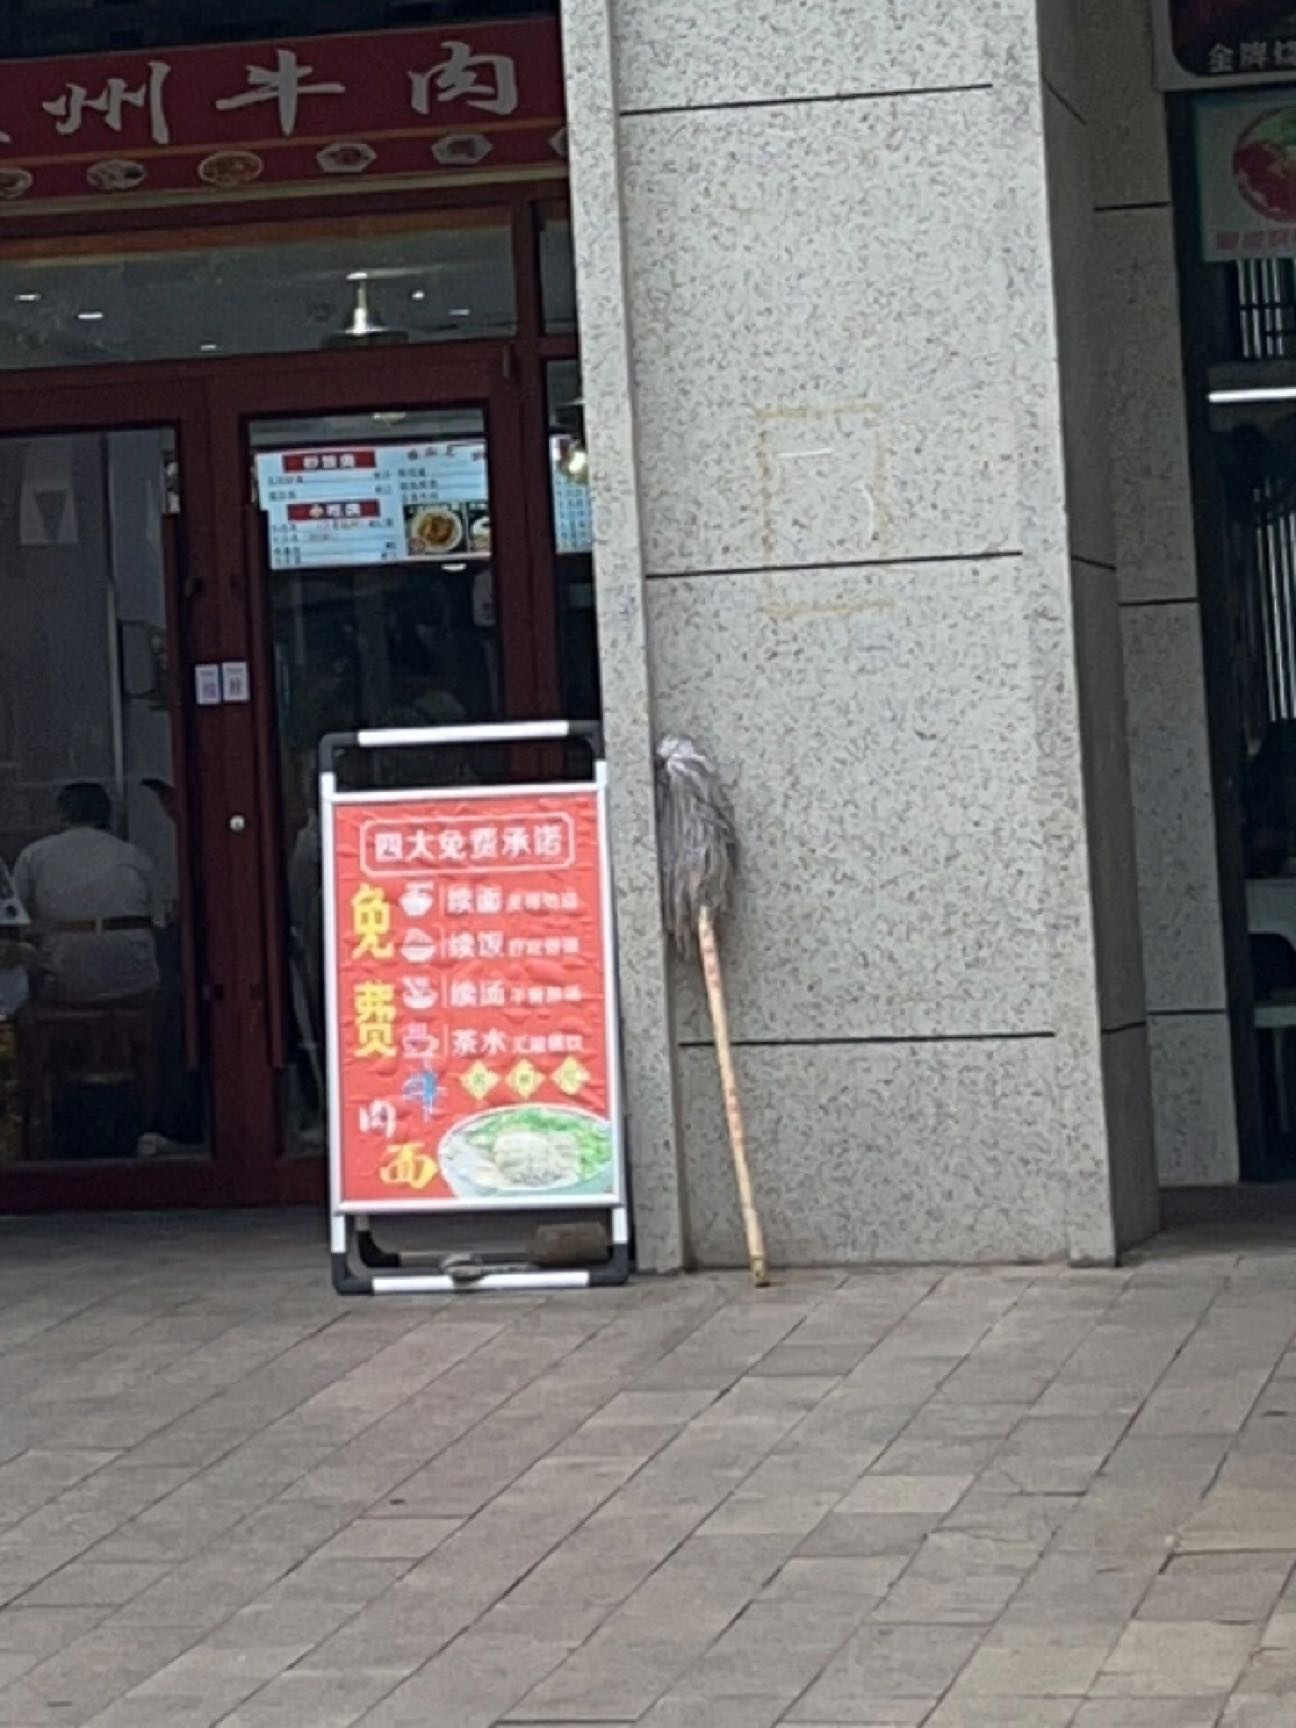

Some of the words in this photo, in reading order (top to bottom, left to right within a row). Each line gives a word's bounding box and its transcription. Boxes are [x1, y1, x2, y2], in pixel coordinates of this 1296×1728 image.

[374, 824, 563, 864] 四大免费承诺
[351, 883, 397, 1058] 免费
[452, 1027, 508, 1058] 茶水
